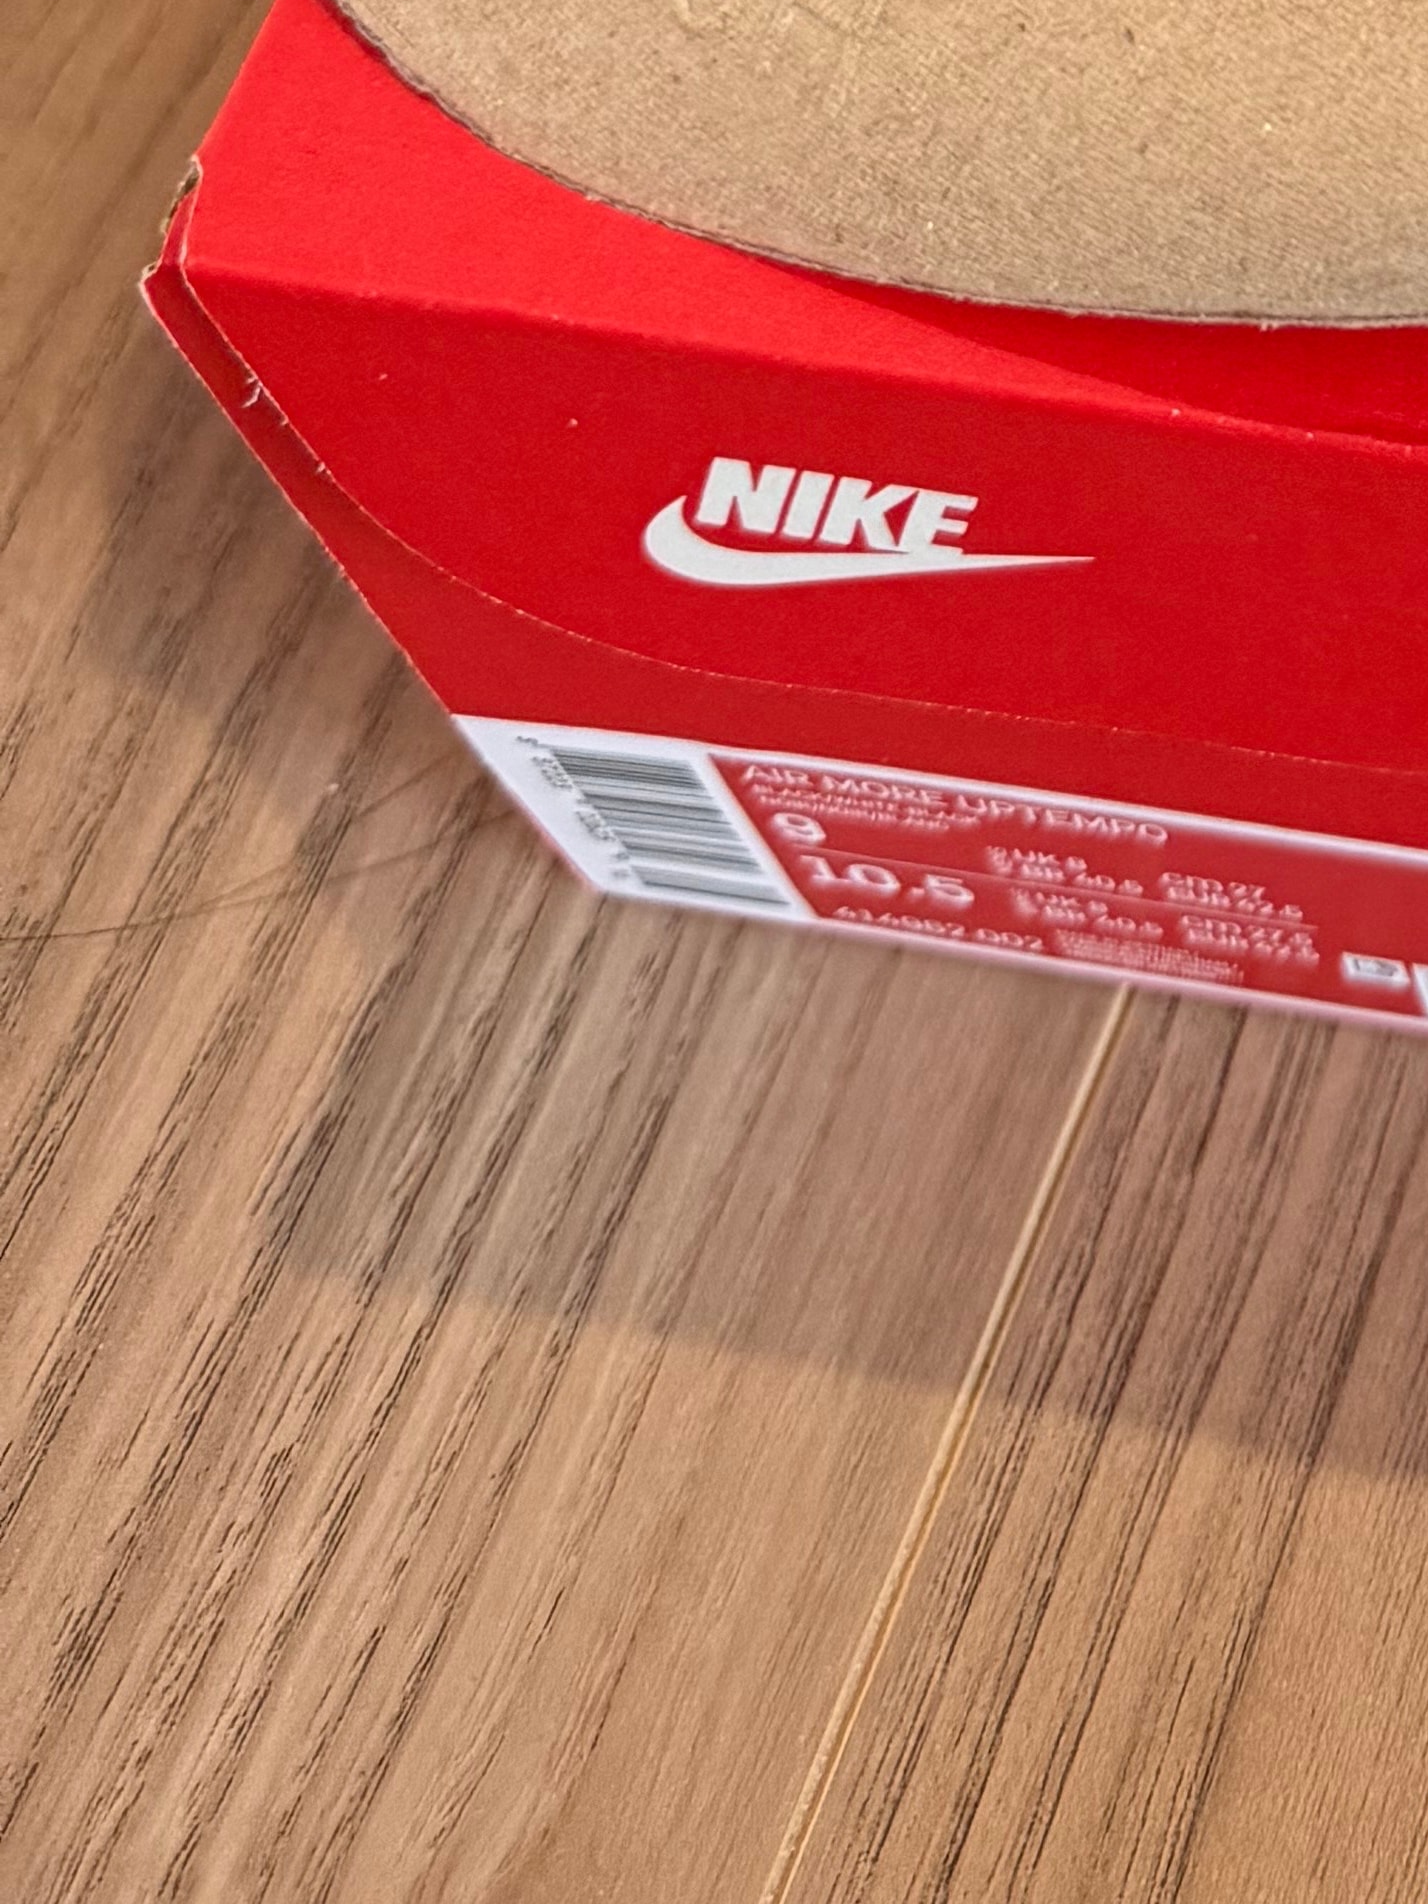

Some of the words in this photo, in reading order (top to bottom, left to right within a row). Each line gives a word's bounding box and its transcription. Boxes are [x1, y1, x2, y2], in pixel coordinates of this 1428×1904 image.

[695, 456, 979, 556] NIKE
[742, 763, 813, 790] AIR
[822, 775, 949, 807] MORE
[957, 794, 1168, 847] UPTEMPO
[770, 812, 828, 847] 9
[799, 854, 976, 909] 10.5
